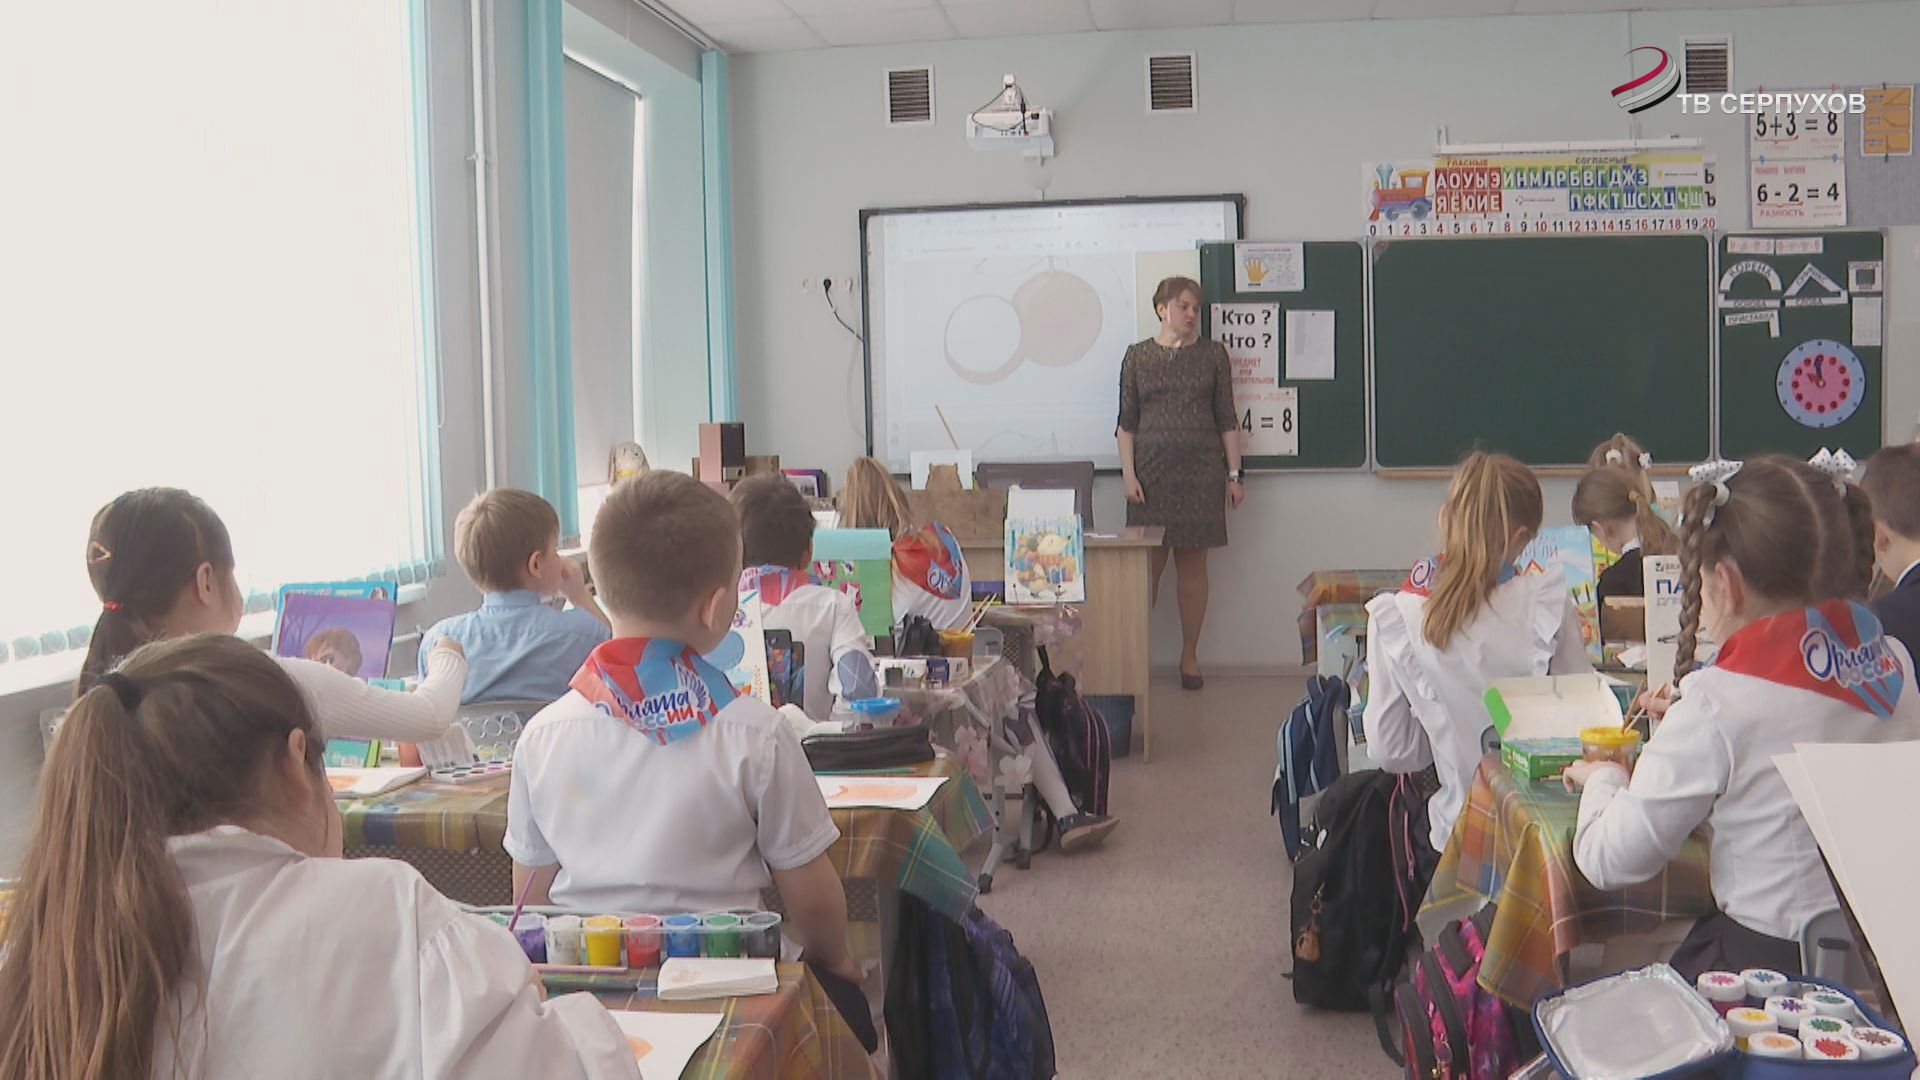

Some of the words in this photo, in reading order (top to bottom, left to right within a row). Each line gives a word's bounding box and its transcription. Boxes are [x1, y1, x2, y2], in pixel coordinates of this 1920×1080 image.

[1827, 111, 1838, 136] 8
[1447, 159, 1488, 167] ГЛАСНЫЕ
[1575, 156, 1628, 165] СОГЛАСНЫЕ
[1757, 183, 1768, 203] 6
[1788, 182, 1800, 202] 2
[1827, 182, 1840, 201] 4
[1760, 209, 1804, 217] РАЗНОСТЬ
[1369, 225, 1377, 236] 0
[1387, 224, 1393, 235] 1
[1403, 224, 1411, 235] 2
[1420, 223, 1427, 235] 3
[1436, 221, 1444, 234] 4
[1454, 221, 1460, 234] 5
[1470, 221, 1477, 233] 6
[1487, 221, 1494, 233] 7
[1504, 221, 1511, 233] 8
[1520, 221, 1528, 233] 9
[1535, 220, 1548, 232] 10
[1552, 220, 1564, 232] 11
[1568, 220, 1581, 232] 12
[1585, 220, 1597, 231] 13
[1602, 219, 1614, 231] 14
[1618, 219, 1631, 231] 15
[1635, 219, 1648, 230] 16
[1652, 218, 1664, 230] 17
[1668, 218, 1681, 230] 18
[1685, 218, 1698, 230] 19
[1702, 218, 1716, 229] 20
[1221, 309, 1255, 325] Кто
[1262, 309, 1272, 325] ?
[1729, 313, 1775, 324] ПРИСТАВКА
[1221, 333, 1256, 348] Что
[1262, 332, 1272, 348] ?
[1241, 408, 1252, 432] 4
[1282, 407, 1292, 433] 8
